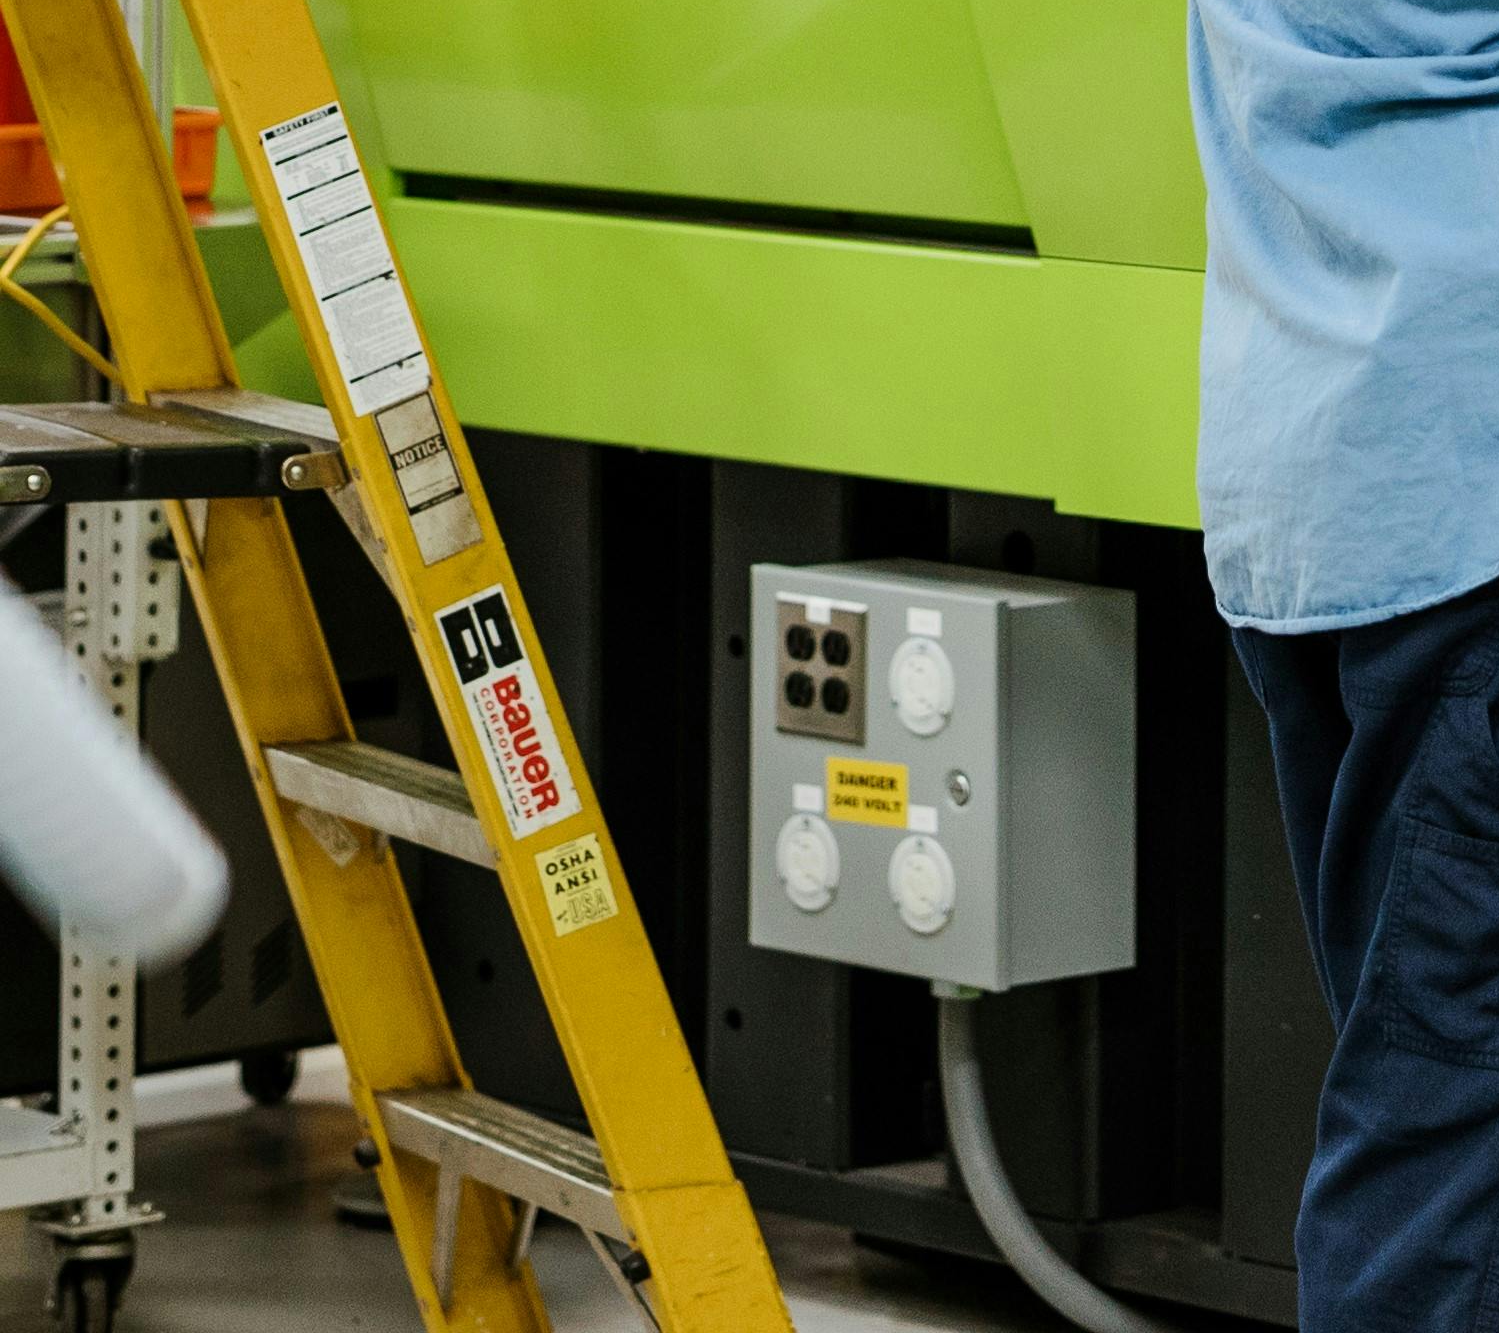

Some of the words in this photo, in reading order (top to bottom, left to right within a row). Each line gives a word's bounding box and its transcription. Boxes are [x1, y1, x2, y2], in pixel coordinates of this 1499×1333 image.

[393, 435, 446, 470] NOTICE
[479, 687, 534, 820] CORPORATION
[837, 770, 898, 792] DANGER
[864, 798, 902, 813] VOLT
[545, 849, 596, 877] OSHA
[554, 869, 599, 895] ANSI
